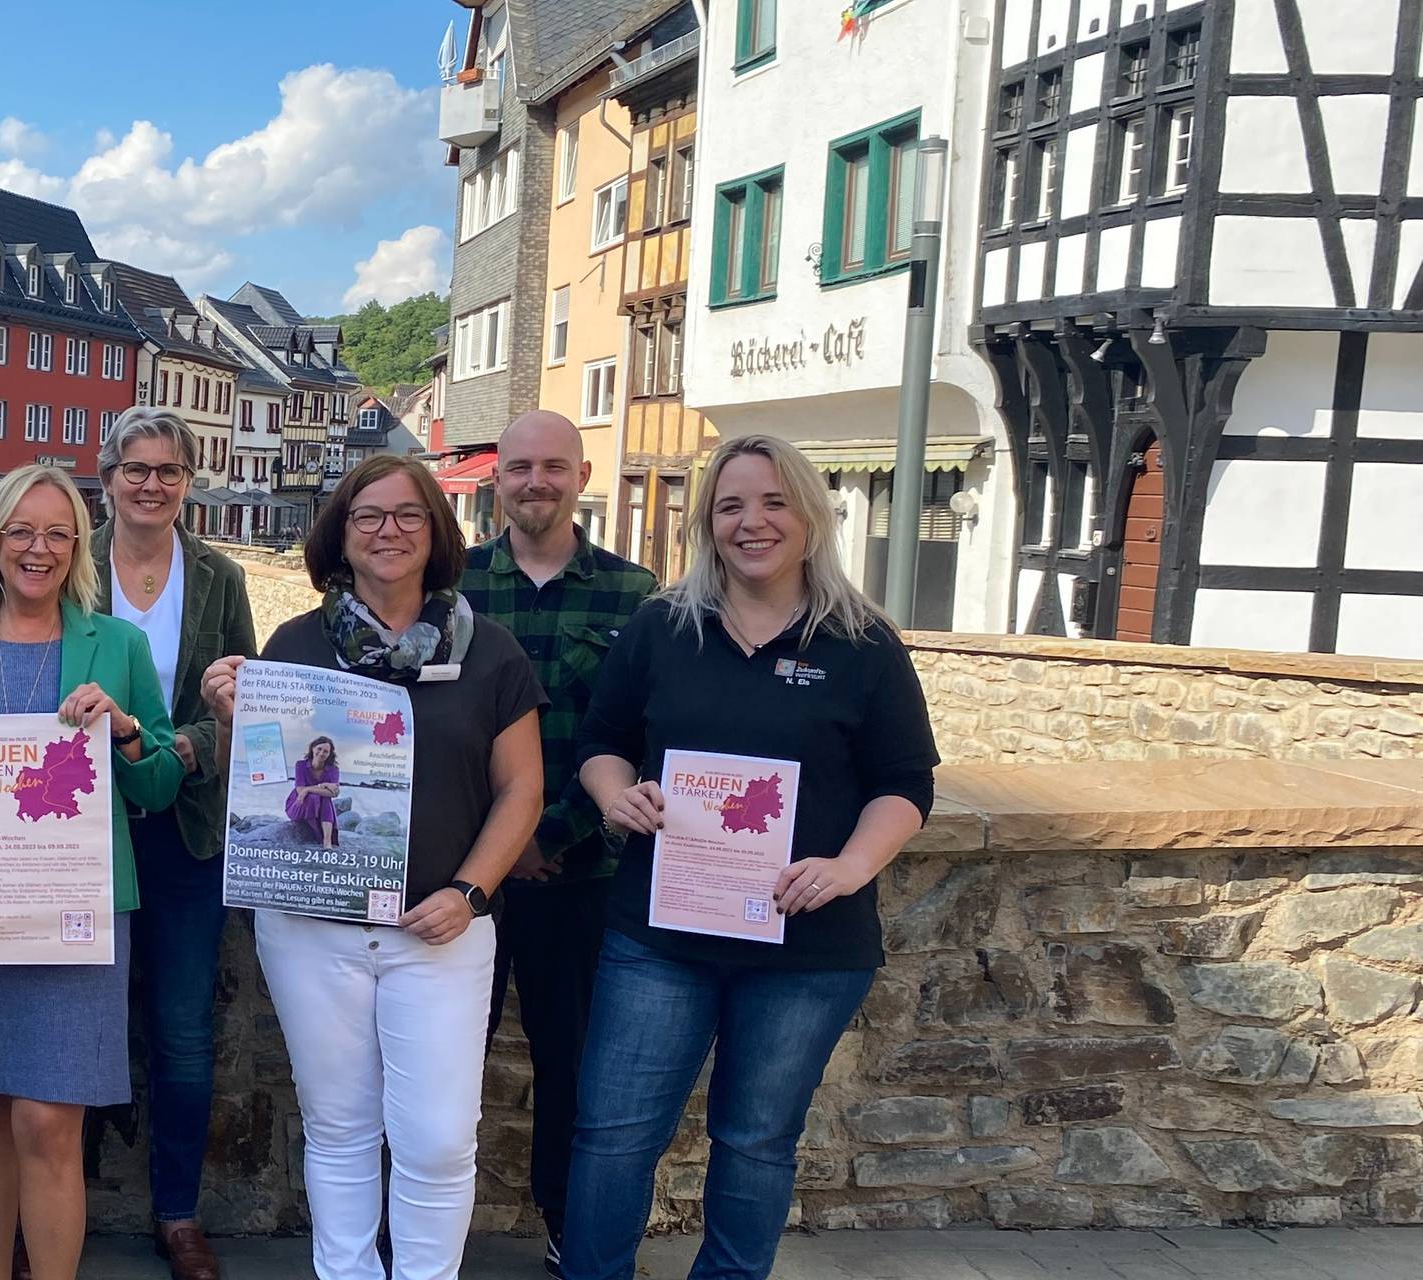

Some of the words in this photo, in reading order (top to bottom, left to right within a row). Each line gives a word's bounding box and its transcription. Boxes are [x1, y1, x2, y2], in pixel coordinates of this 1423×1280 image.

[730, 329, 806, 377] Bäckerei
[823, 317, 867, 367] Café
[243, 667, 263, 676] Tessa
[264, 668, 294, 678] Randau
[295, 669, 311, 680] liest
[313, 672, 324, 681] zur
[242, 679, 255, 687] der
[360, 690, 377, 699] 2023
[256, 692, 278, 701] ihrem
[259, 704, 279, 714] Meer
[280, 706, 296, 715] und
[346, 709, 384, 721] FRAUEN
[674, 773, 742, 792] FRAUEN
[228, 844, 302, 865] Donnerstag,
[304, 850, 360, 868] 24.08.23,
[363, 855, 378, 868] 19
[381, 856, 404, 871] Uhr
[227, 878, 262, 888] Programm
[262, 881, 275, 889] der
[228, 862, 319, 883] Stadttheater
[322, 871, 402, 890] Euskirchen
[240, 889, 263, 898] Karten
[263, 891, 274, 899] für
[274, 892, 286, 900] die
[286, 893, 311, 904] Lesung
[311, 896, 325, 906] gibt
